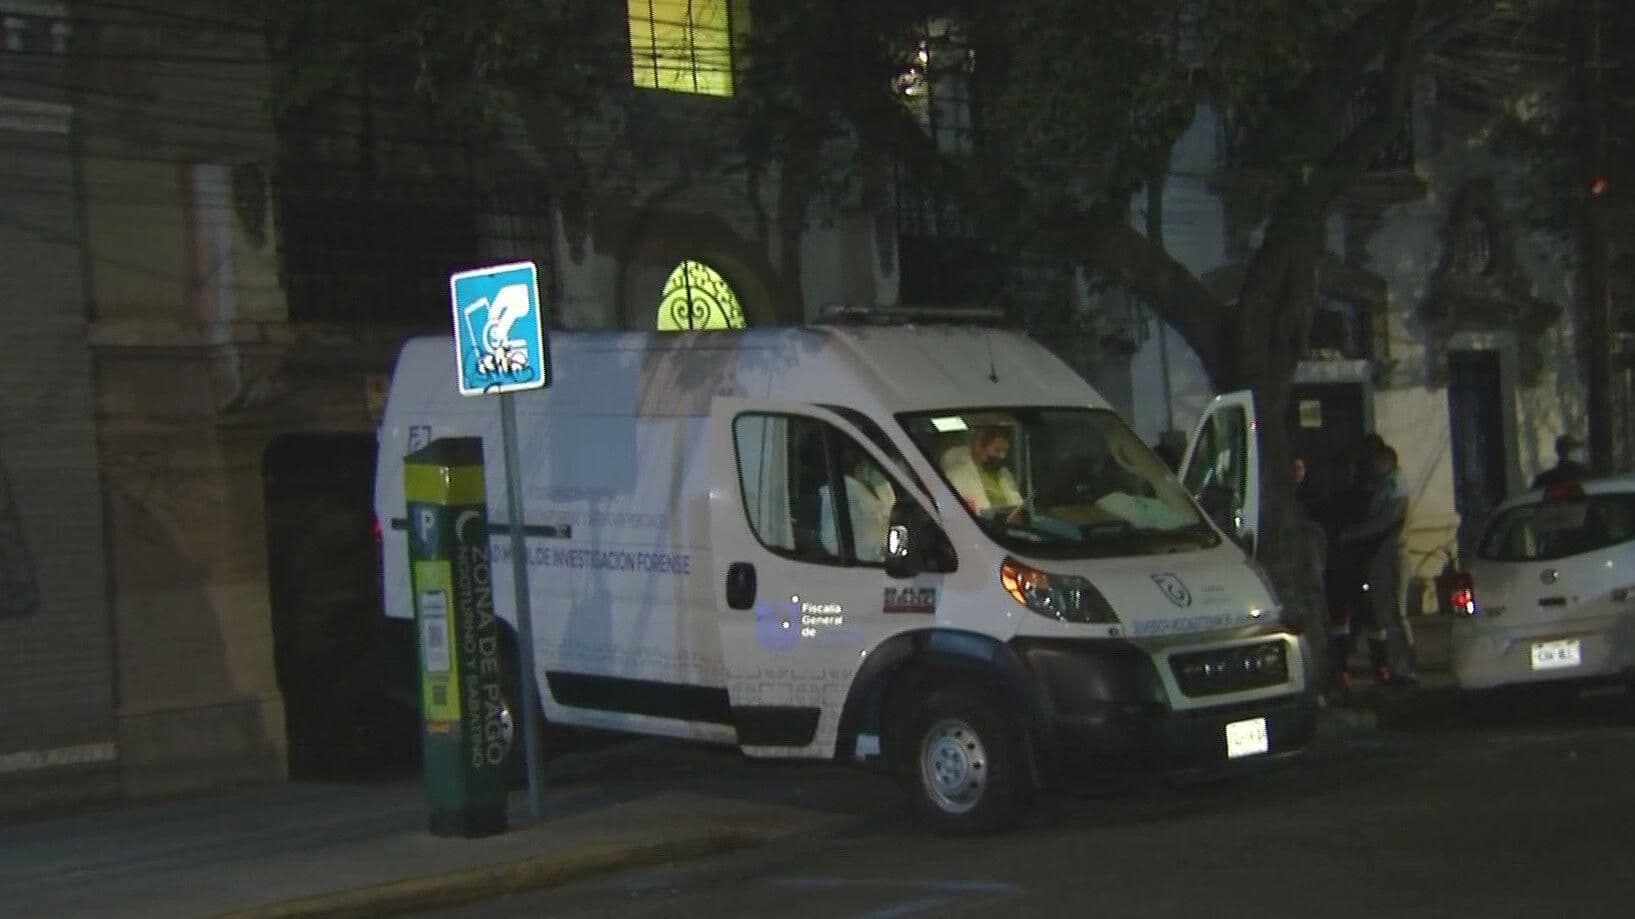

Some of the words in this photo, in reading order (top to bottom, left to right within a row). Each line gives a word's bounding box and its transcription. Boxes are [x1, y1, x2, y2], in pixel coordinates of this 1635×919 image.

[420, 509, 435, 542] P
[639, 552, 691, 576] FORENSE
[471, 543, 493, 629] ZONA
[801, 627, 816, 638] de
[802, 615, 843, 625] General
[479, 636, 498, 673] DE
[483, 684, 504, 765] PAGO
